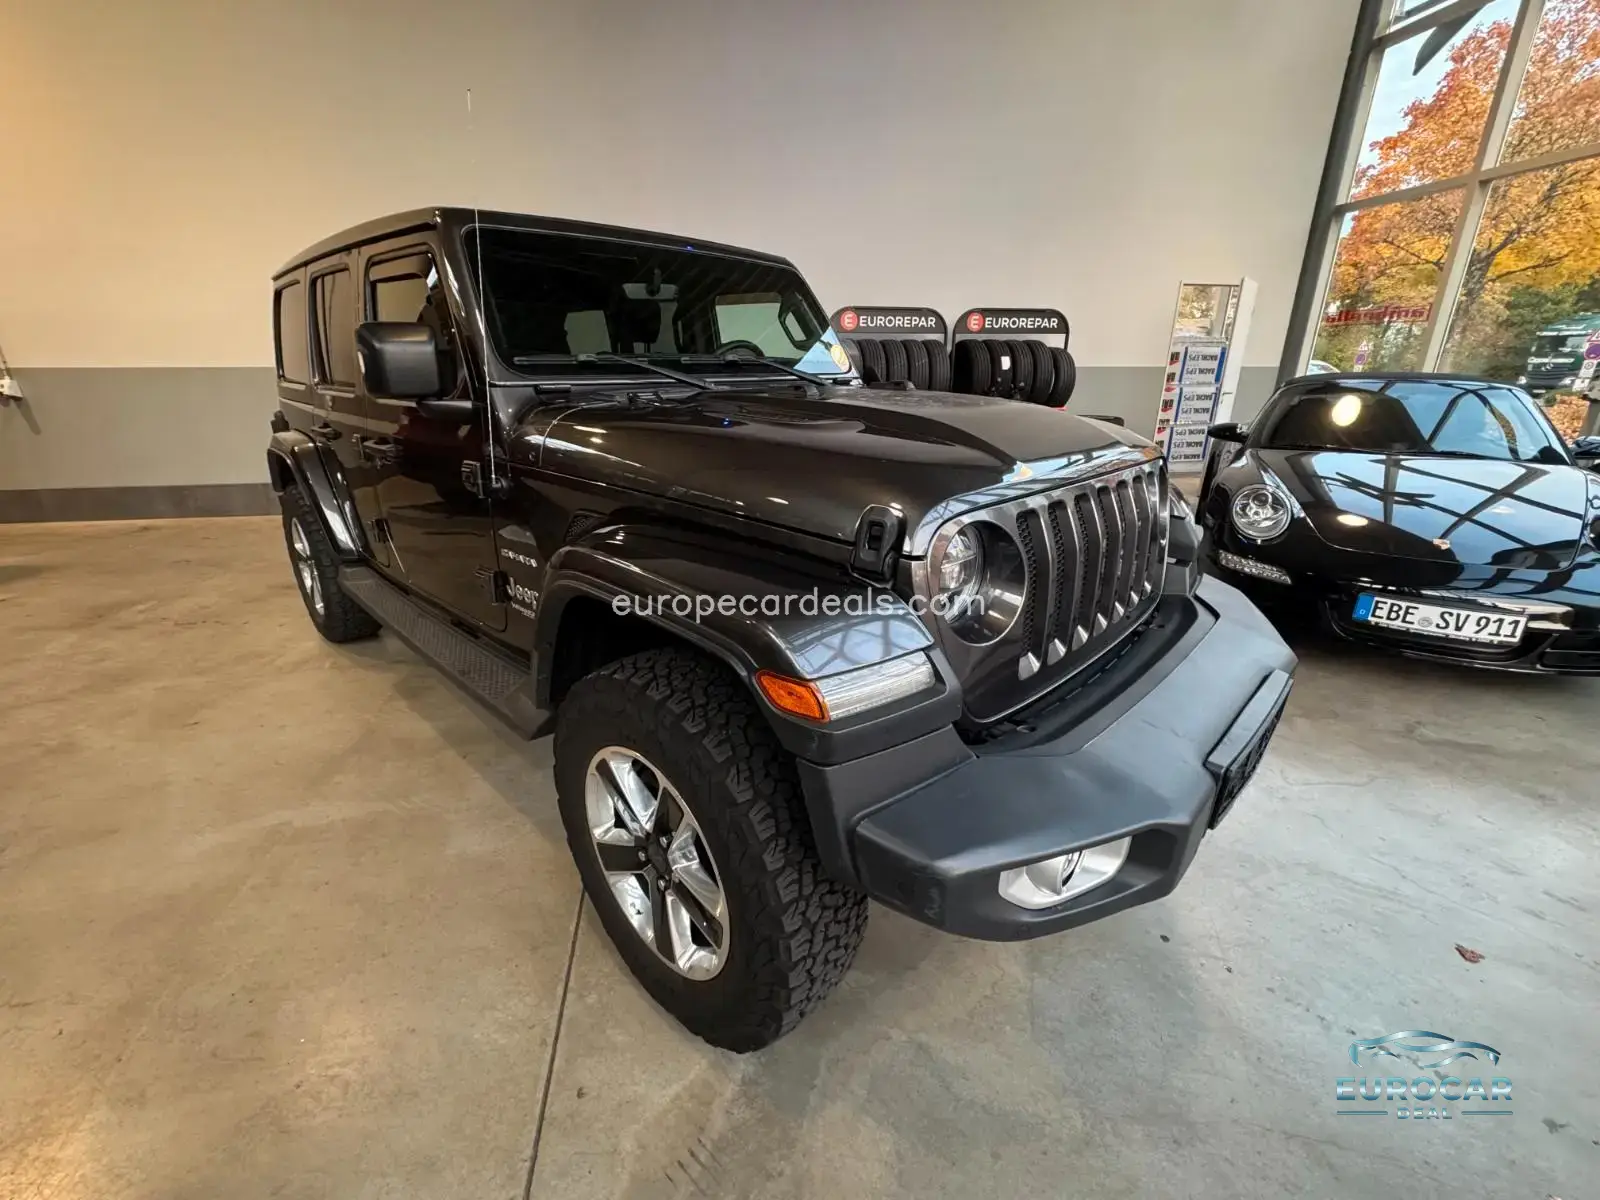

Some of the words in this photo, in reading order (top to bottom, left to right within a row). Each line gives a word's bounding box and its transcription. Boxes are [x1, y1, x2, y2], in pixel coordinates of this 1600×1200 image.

[859, 315, 936, 328] EUROREPAR
[984, 316, 1058, 329] EUROREPAR
[506, 576, 539, 610] Jeep
[1370, 600, 1419, 625] EBE
[1435, 610, 1472, 632] SV
[1474, 615, 1521, 639] 911
